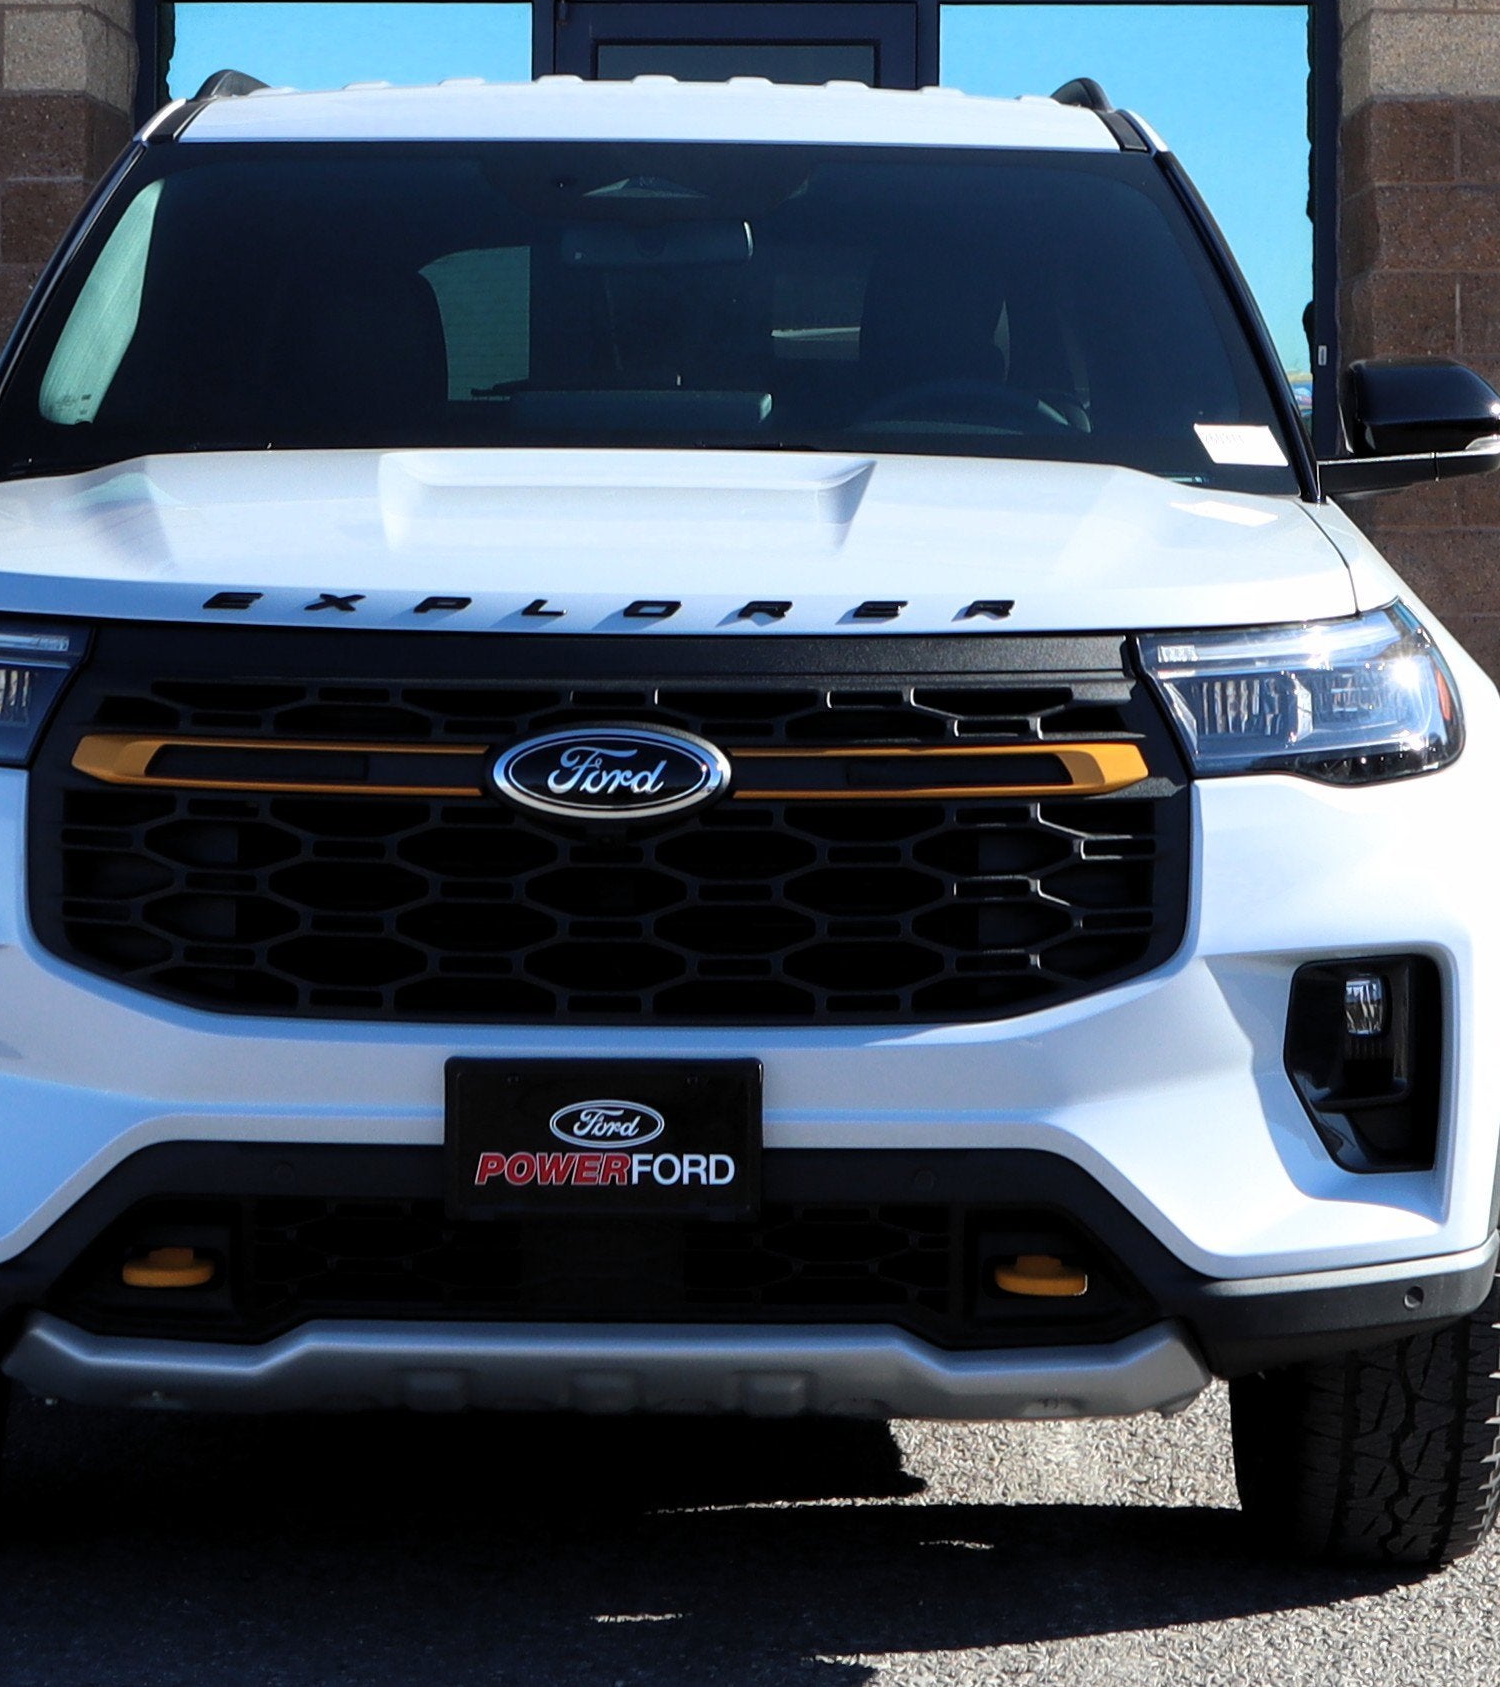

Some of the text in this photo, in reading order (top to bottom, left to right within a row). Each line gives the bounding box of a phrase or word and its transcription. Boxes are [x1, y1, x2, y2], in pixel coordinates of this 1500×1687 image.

[201, 590, 1019, 620] EXPLORER
[547, 746, 667, 796] Ford
[573, 1108, 640, 1138] Ford
